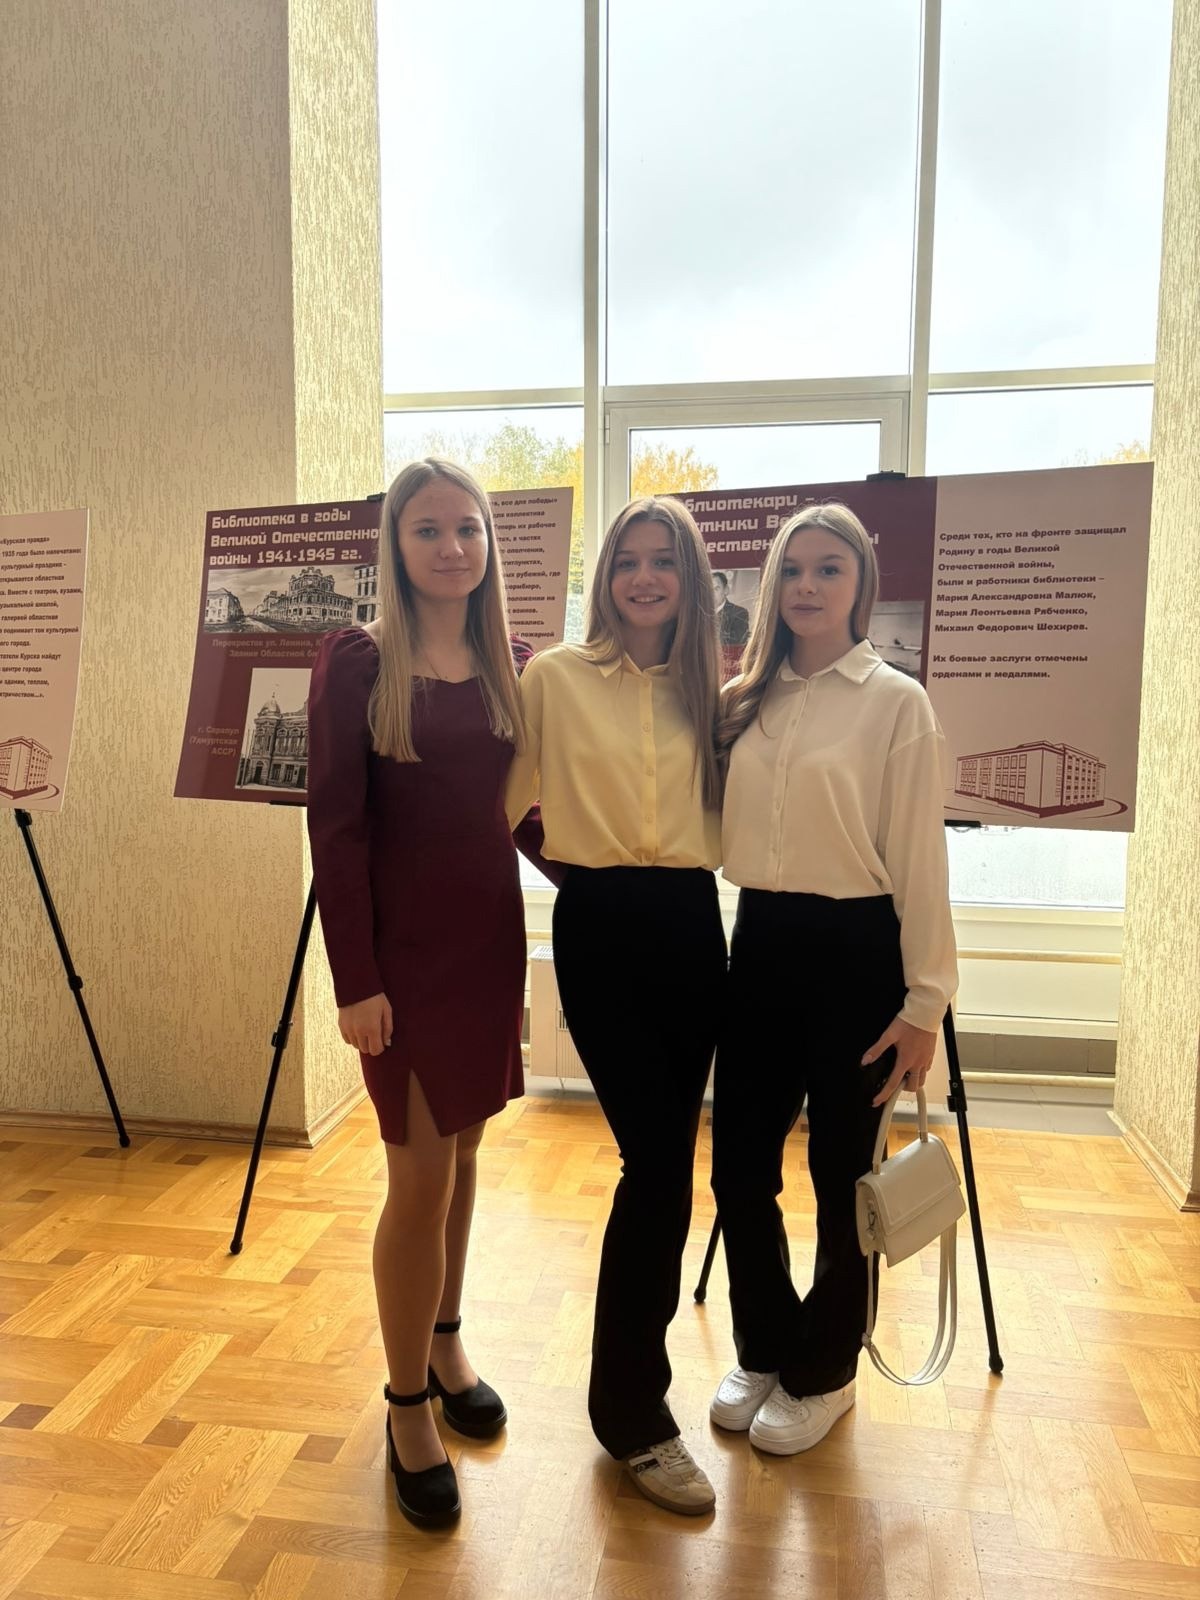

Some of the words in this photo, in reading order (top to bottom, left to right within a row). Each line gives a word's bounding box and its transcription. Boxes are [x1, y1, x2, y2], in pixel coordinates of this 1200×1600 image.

[684, 494, 798, 513] блиотекари
[212, 514, 296, 529] Библиотека
[300, 513, 308, 524] в
[314, 508, 350, 522] годы
[696, 518, 759, 532] тники
[211, 532, 266, 548] Великой
[272, 528, 382, 544] Отечественно
[940, 533, 970, 542] Среди
[1031, 528, 1071, 538] фронте
[1074, 526, 1126, 536] защищал
[210, 552, 251, 566] войны
[257, 548, 336, 564] 1941-1945
[939, 548, 974, 557] Родину
[986, 546, 1012, 555] годы
[1014, 544, 1060, 553] Великой
[938, 561, 1015, 571] Отечественной
[1018, 561, 1055, 570] войны,
[937, 577, 964, 586] были
[976, 576, 1030, 587] работники
[1033, 574, 1096, 584] библиотеки
[936, 594, 969, 602] Мария
[972, 592, 1052, 602] Александровна
[1056, 592, 1096, 600] Малюк,
[936, 609, 968, 618] Мария
[970, 608, 1031, 616] Леонтьевна
[1034, 608, 1088, 616] Рябченко,
[935, 624, 974, 632] Михаил
[976, 624, 1034, 633] Федорович
[990, 656, 1032, 664] заслуги
[994, 671, 1050, 679] медалями.
